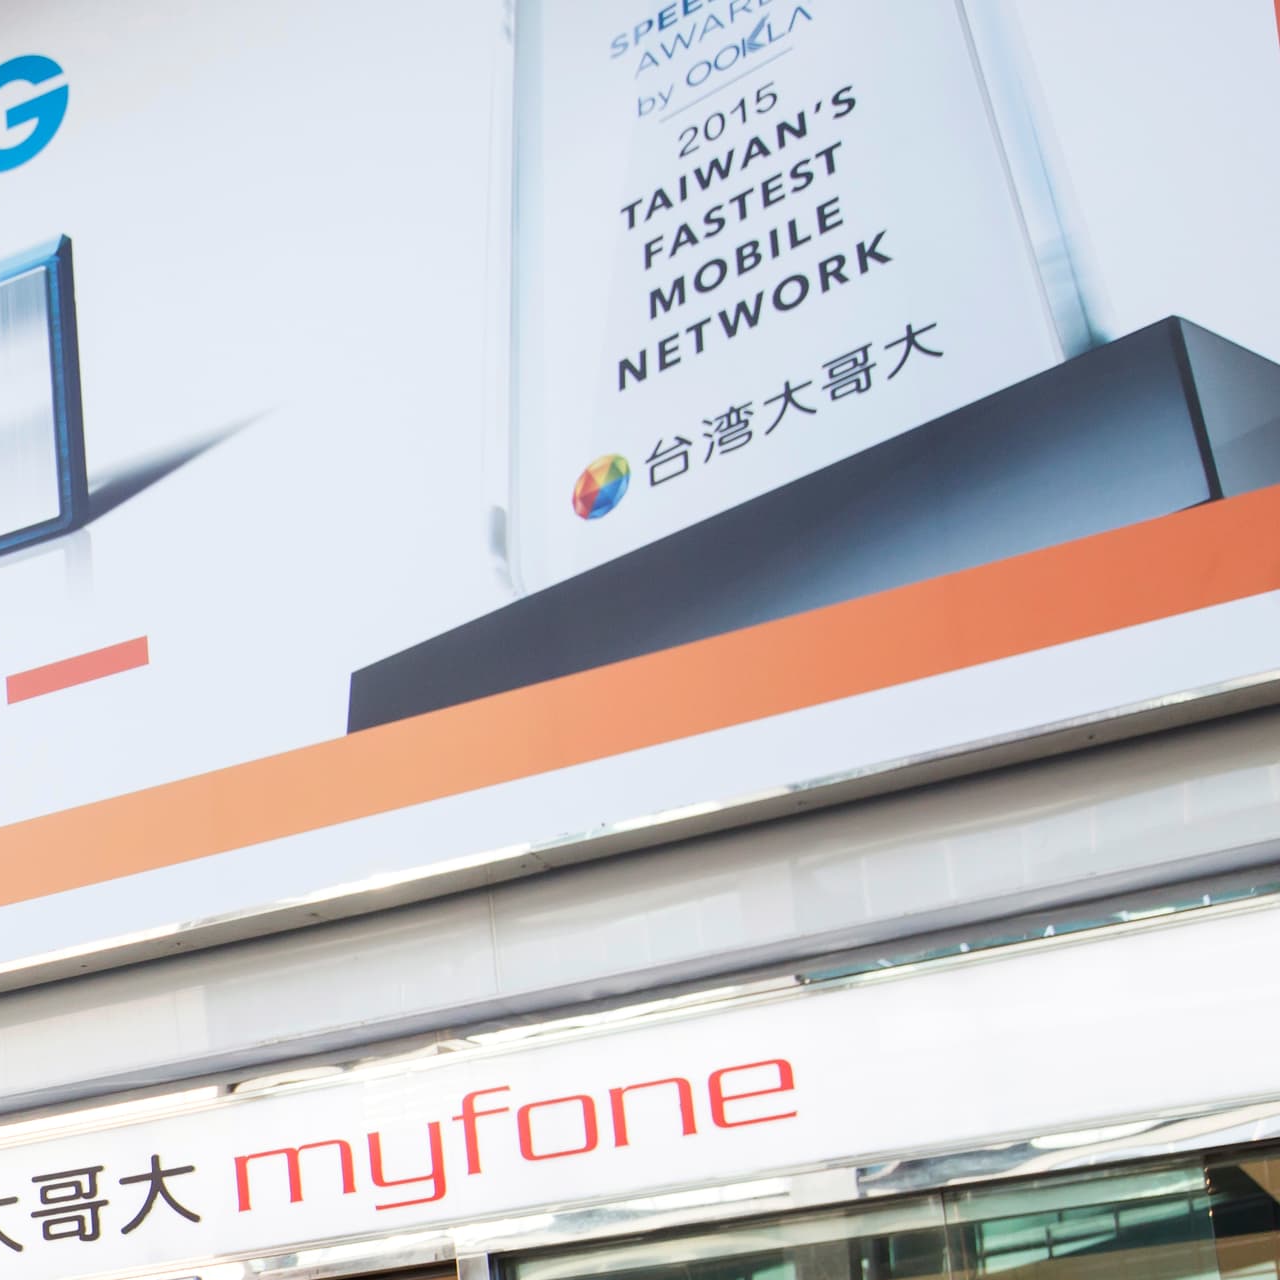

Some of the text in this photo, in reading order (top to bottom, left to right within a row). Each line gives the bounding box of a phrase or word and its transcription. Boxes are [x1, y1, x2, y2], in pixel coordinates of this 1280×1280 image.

[638, 6, 813, 118] by OOKLA
[677, 81, 778, 158] 2015
[620, 84, 858, 231] TAIWAN'S
[642, 141, 843, 270] FASTEST
[616, 230, 894, 392] NETWORK
[648, 196, 844, 320] MOBILE
[234, 1058, 800, 1217] myfone
